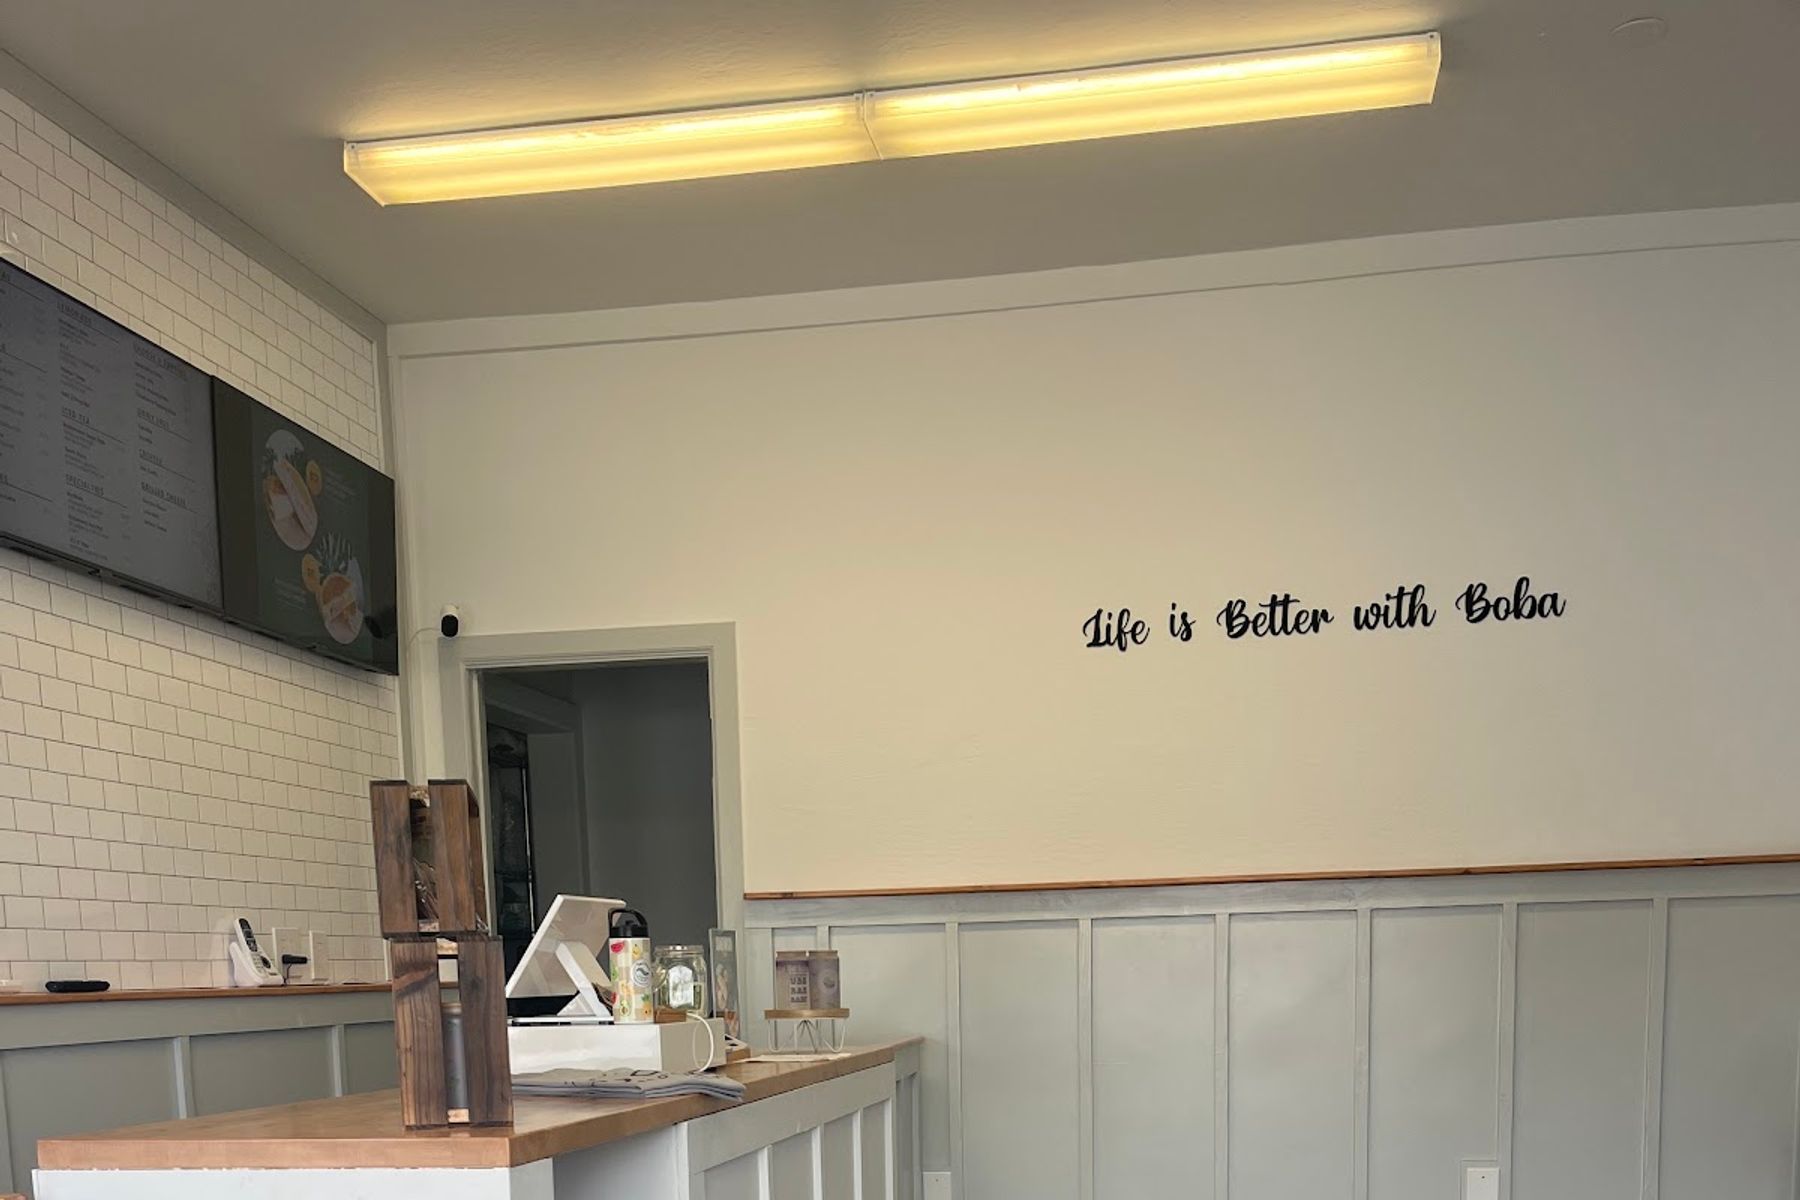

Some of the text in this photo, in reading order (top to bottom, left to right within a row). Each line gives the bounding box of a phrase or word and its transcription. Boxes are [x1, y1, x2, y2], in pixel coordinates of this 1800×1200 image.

[1083, 577, 1566, 651] Life is Better with Boba
